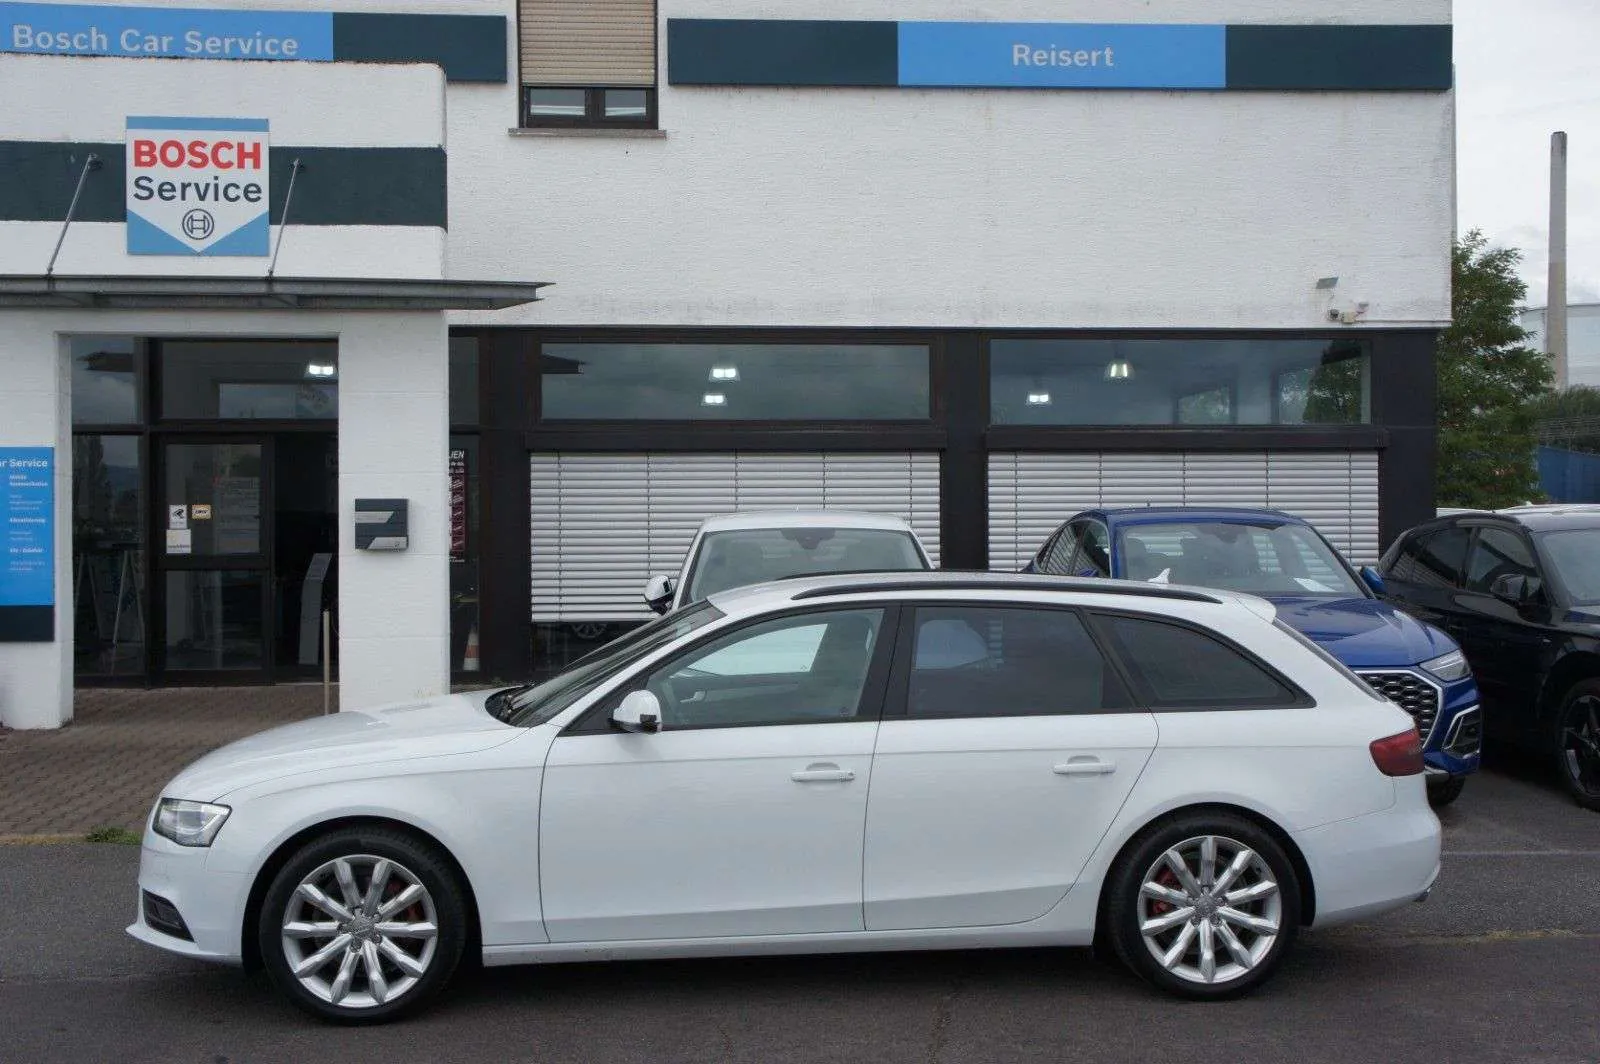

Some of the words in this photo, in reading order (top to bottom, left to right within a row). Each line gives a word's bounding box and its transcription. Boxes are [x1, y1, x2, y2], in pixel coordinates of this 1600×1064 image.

[12, 24, 108, 51] Bosch
[120, 28, 174, 53] Car
[184, 30, 299, 56] Service
[1012, 43, 1114, 67] Reisert
[133, 139, 261, 170] BOSCH
[133, 175, 262, 203] Service
[9, 458, 48, 468] Service
